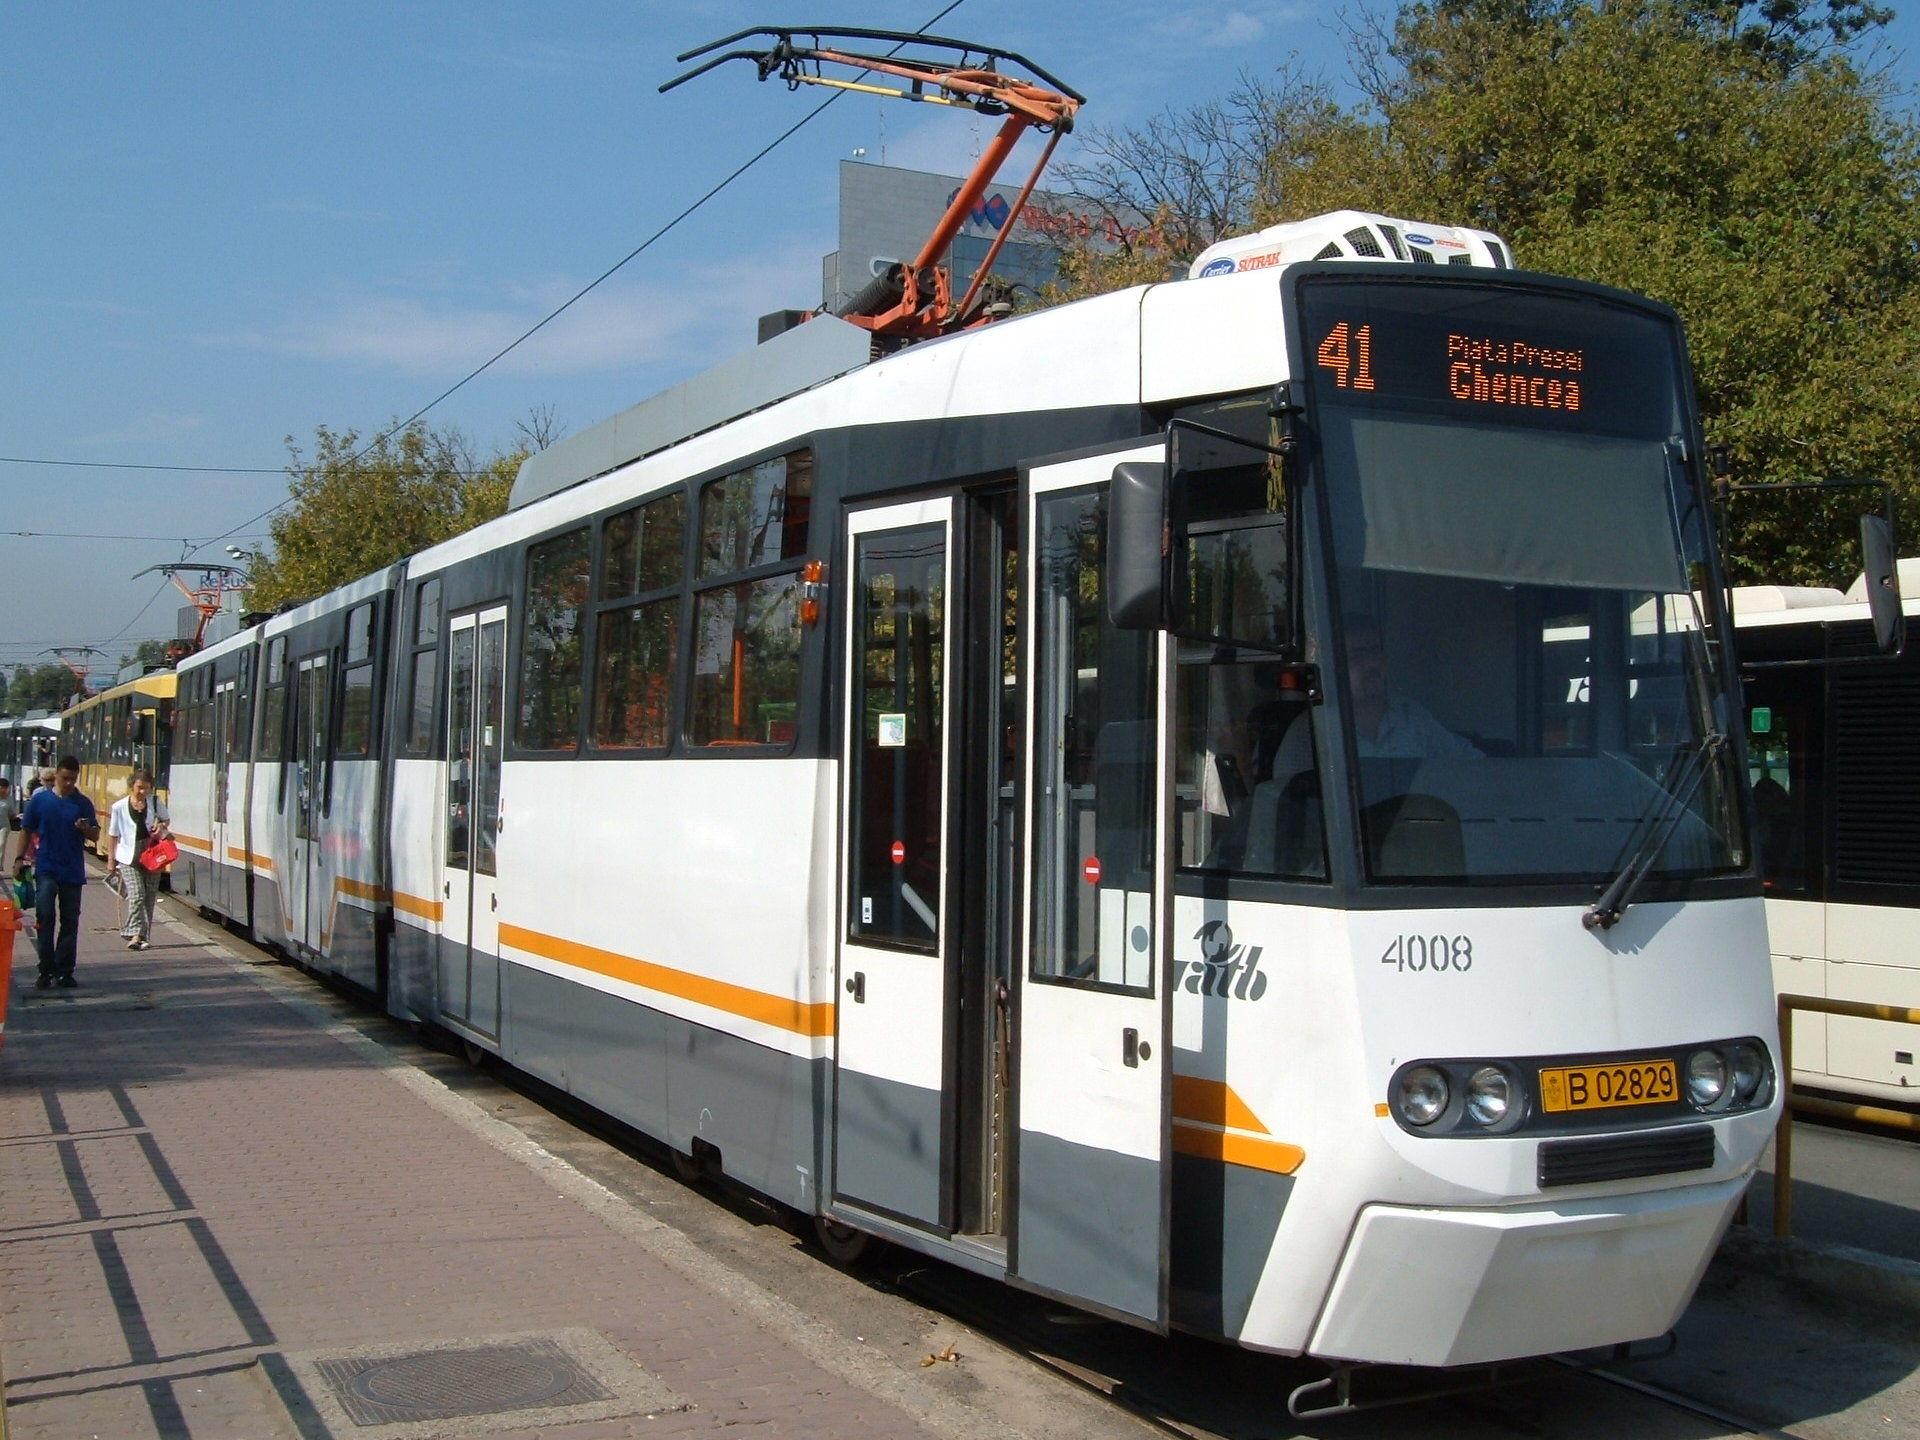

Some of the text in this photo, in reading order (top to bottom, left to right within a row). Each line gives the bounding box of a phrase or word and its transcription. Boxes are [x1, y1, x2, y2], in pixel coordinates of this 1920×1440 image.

[1317, 322, 1375, 390] 41
[1449, 334, 1583, 371] Piata Presei
[1450, 361, 1580, 411] Ghencea
[1381, 934, 1472, 972] 4008
[1568, 1072, 1589, 1105] B
[1596, 1065, 1673, 1102] 02829
